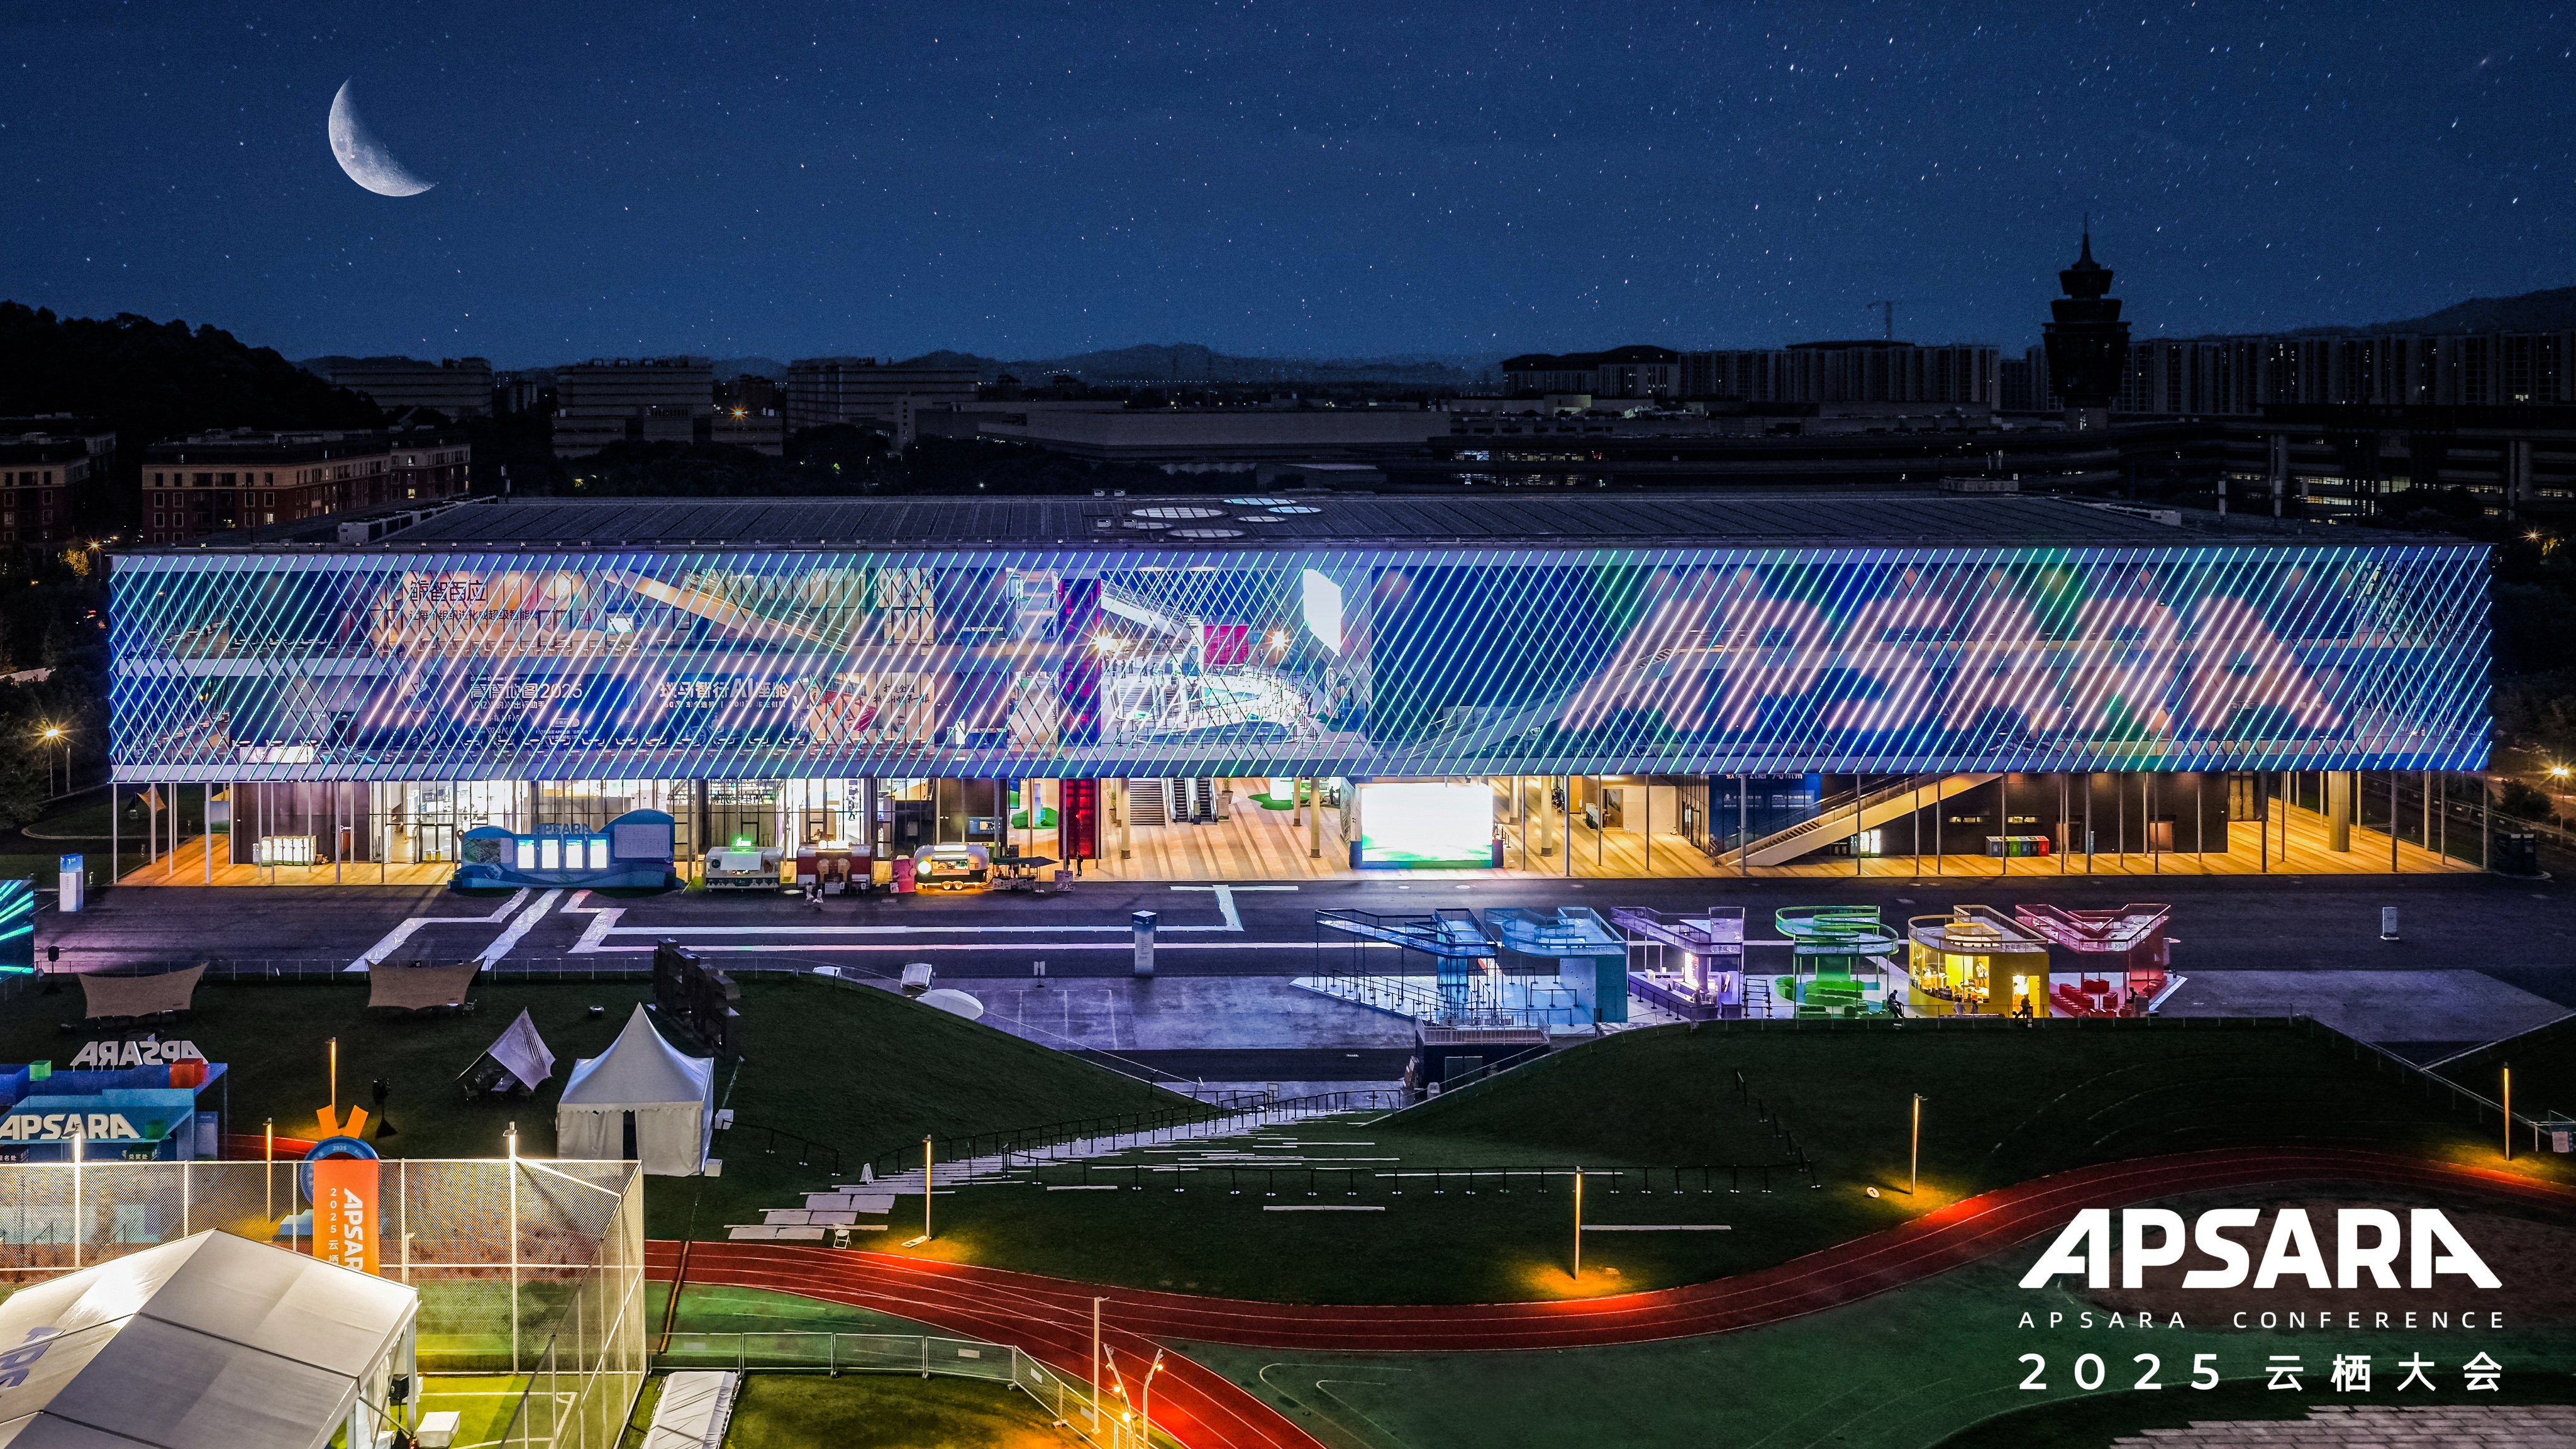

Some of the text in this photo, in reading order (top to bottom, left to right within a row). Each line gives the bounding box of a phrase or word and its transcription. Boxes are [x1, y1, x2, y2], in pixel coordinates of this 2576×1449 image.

[1560, 595, 2342, 731] APSARA
[531, 823, 594, 835] APSARA
[0, 1113, 141, 1140] APSARA
